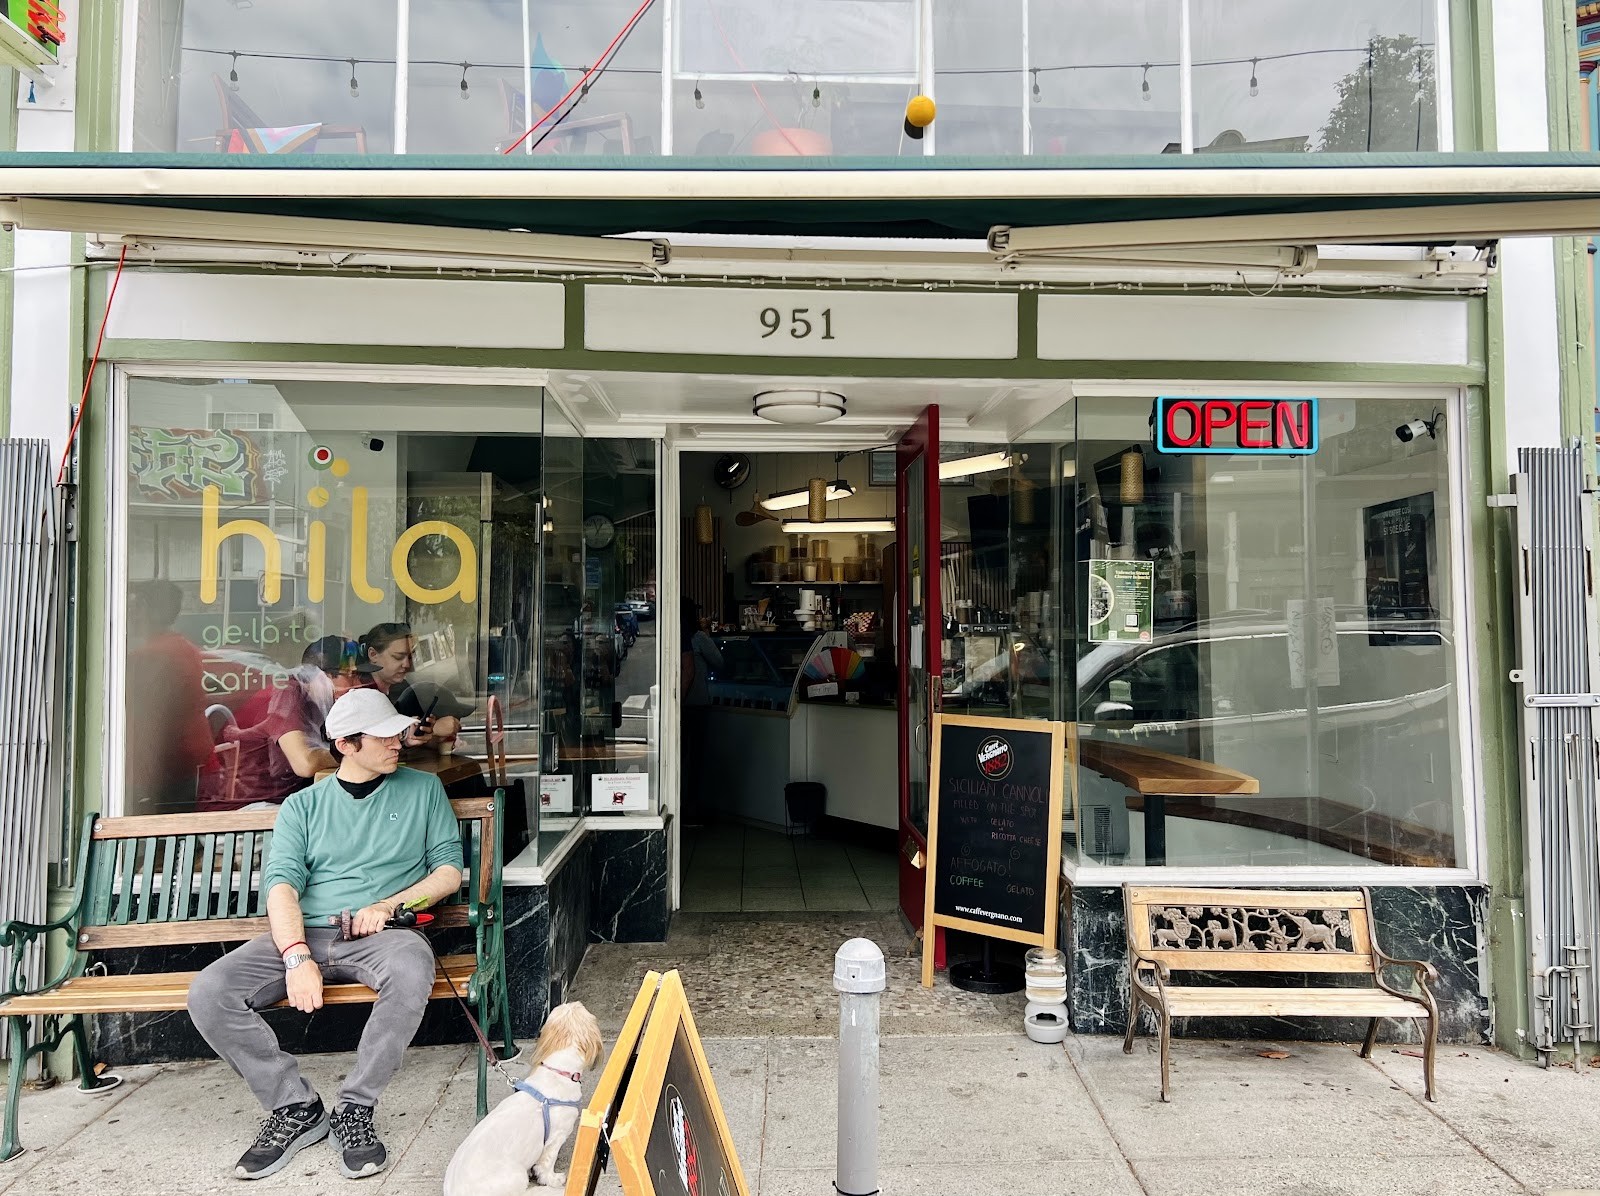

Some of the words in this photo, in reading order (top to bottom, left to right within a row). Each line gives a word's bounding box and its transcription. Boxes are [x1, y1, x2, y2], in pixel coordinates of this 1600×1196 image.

[760, 307, 835, 340] 951
[1166, 400, 1309, 448] OPEN
[199, 484, 477, 605] hila
[985, 753, 1008, 775] 1882
[948, 777, 996, 797] SICILIAN
[1002, 783, 1049, 806] CANNOLI
[953, 799, 980, 810] FILLED
[986, 802, 998, 813] ON
[1000, 802, 1015, 815] THE
[1020, 805, 1037, 818] SPOT
[990, 817, 1015, 828] GELATO
[991, 831, 1017, 842] RICOTTA
[1019, 835, 1042, 847] CHEESE
[949, 874, 985, 888] COFFEE
[1006, 883, 1035, 896] GELATO
[954, 905, 1023, 924] www.caffevergnano.com
